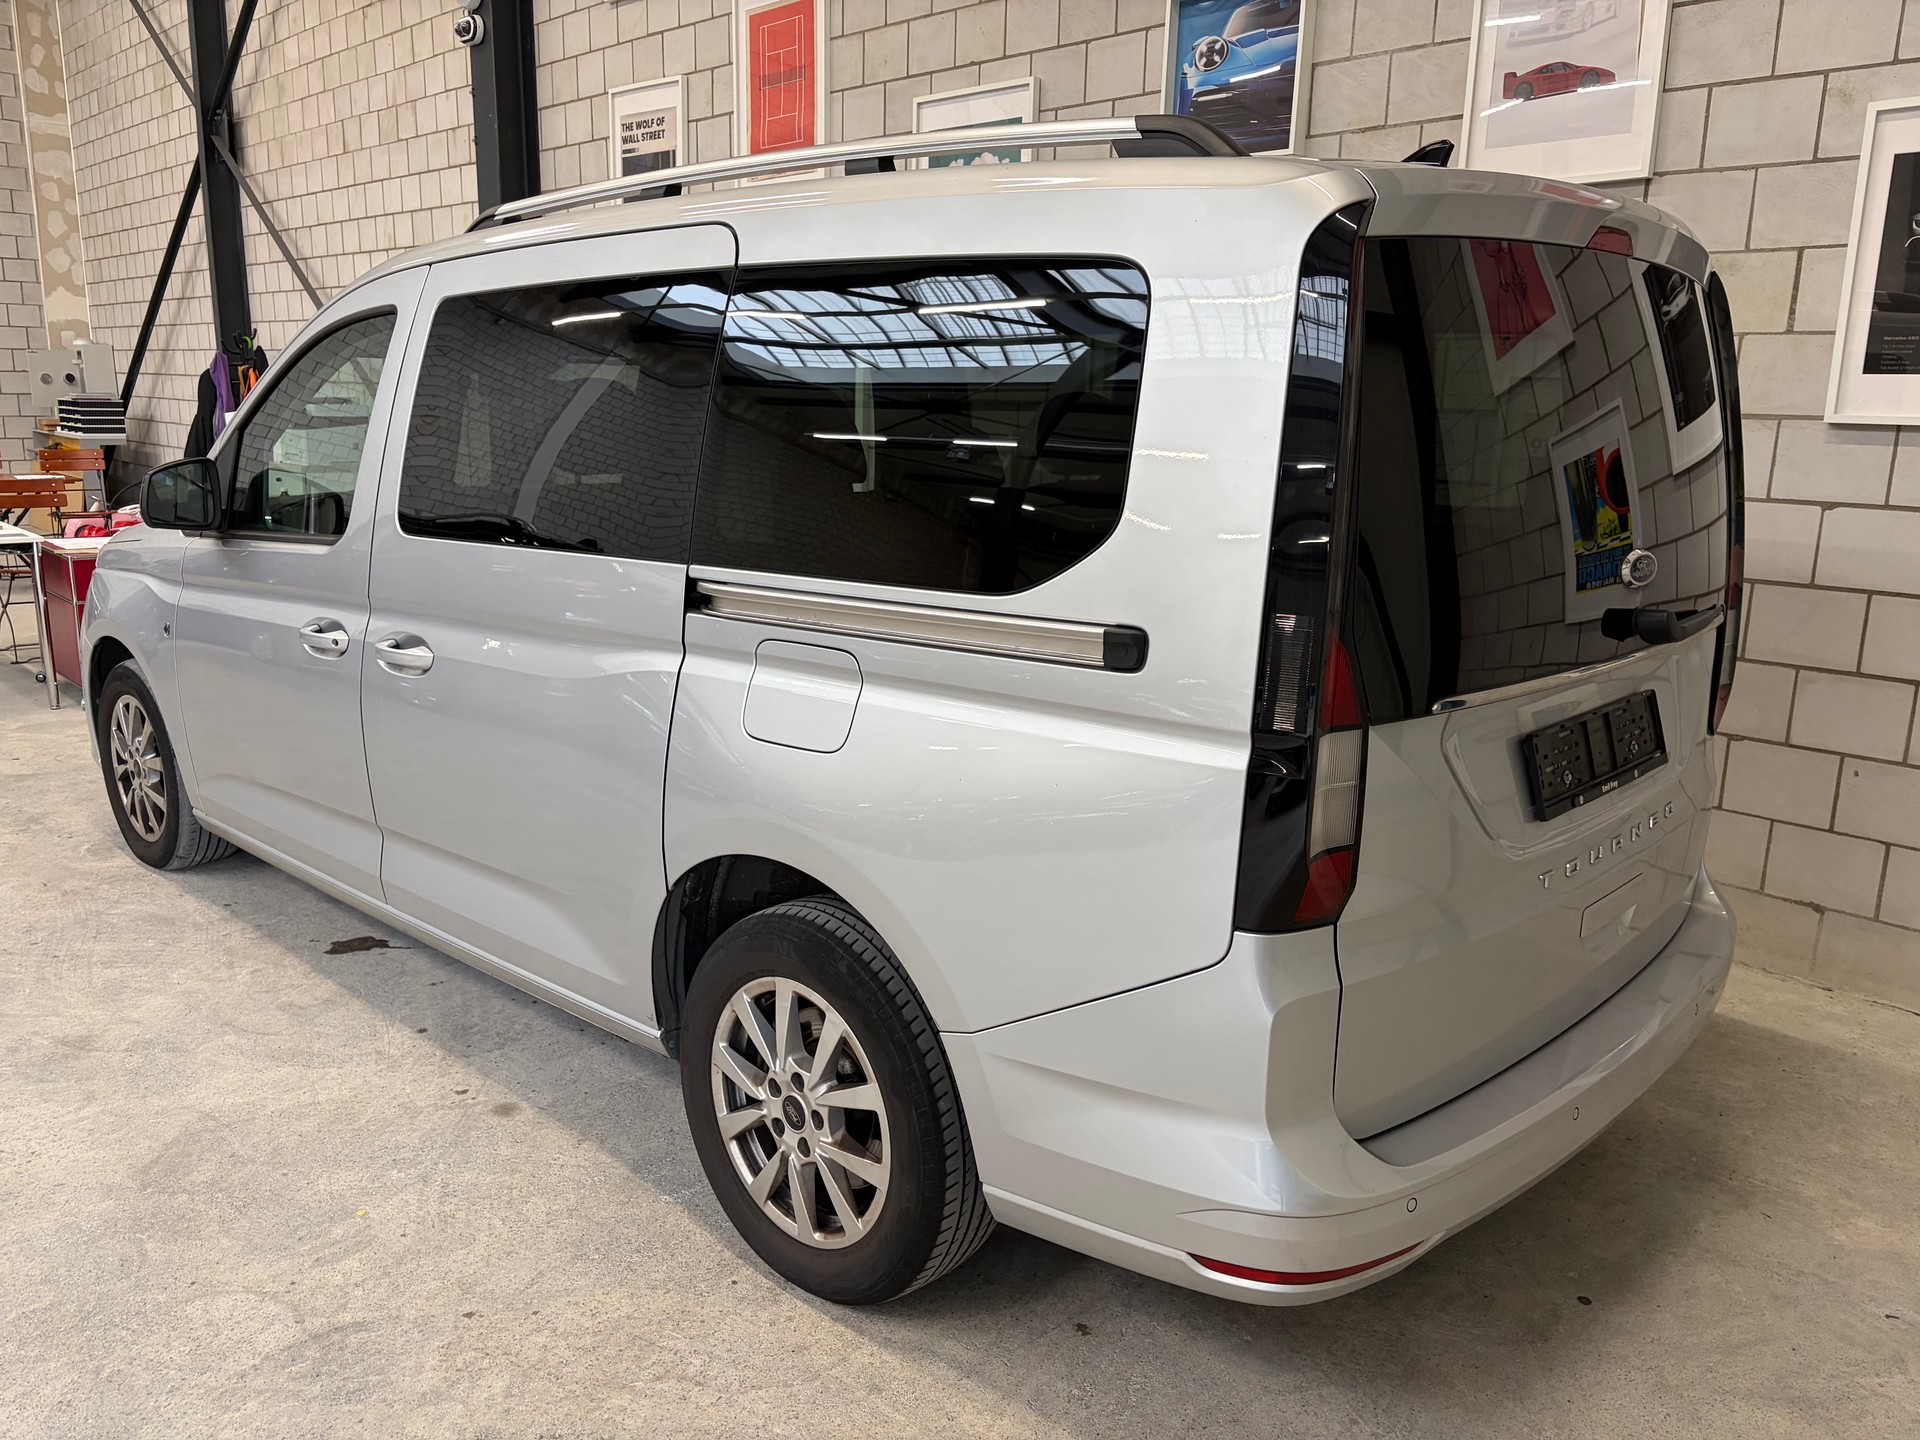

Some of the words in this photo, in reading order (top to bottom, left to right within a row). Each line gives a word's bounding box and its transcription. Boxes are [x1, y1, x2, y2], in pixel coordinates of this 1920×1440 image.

[621, 121, 635, 133] THE
[635, 118, 655, 131] WOLF
[656, 116, 666, 127] OF
[621, 133, 640, 145] WALL
[641, 129, 666, 142] STREET
[1538, 801, 1674, 888] TOURNEO
